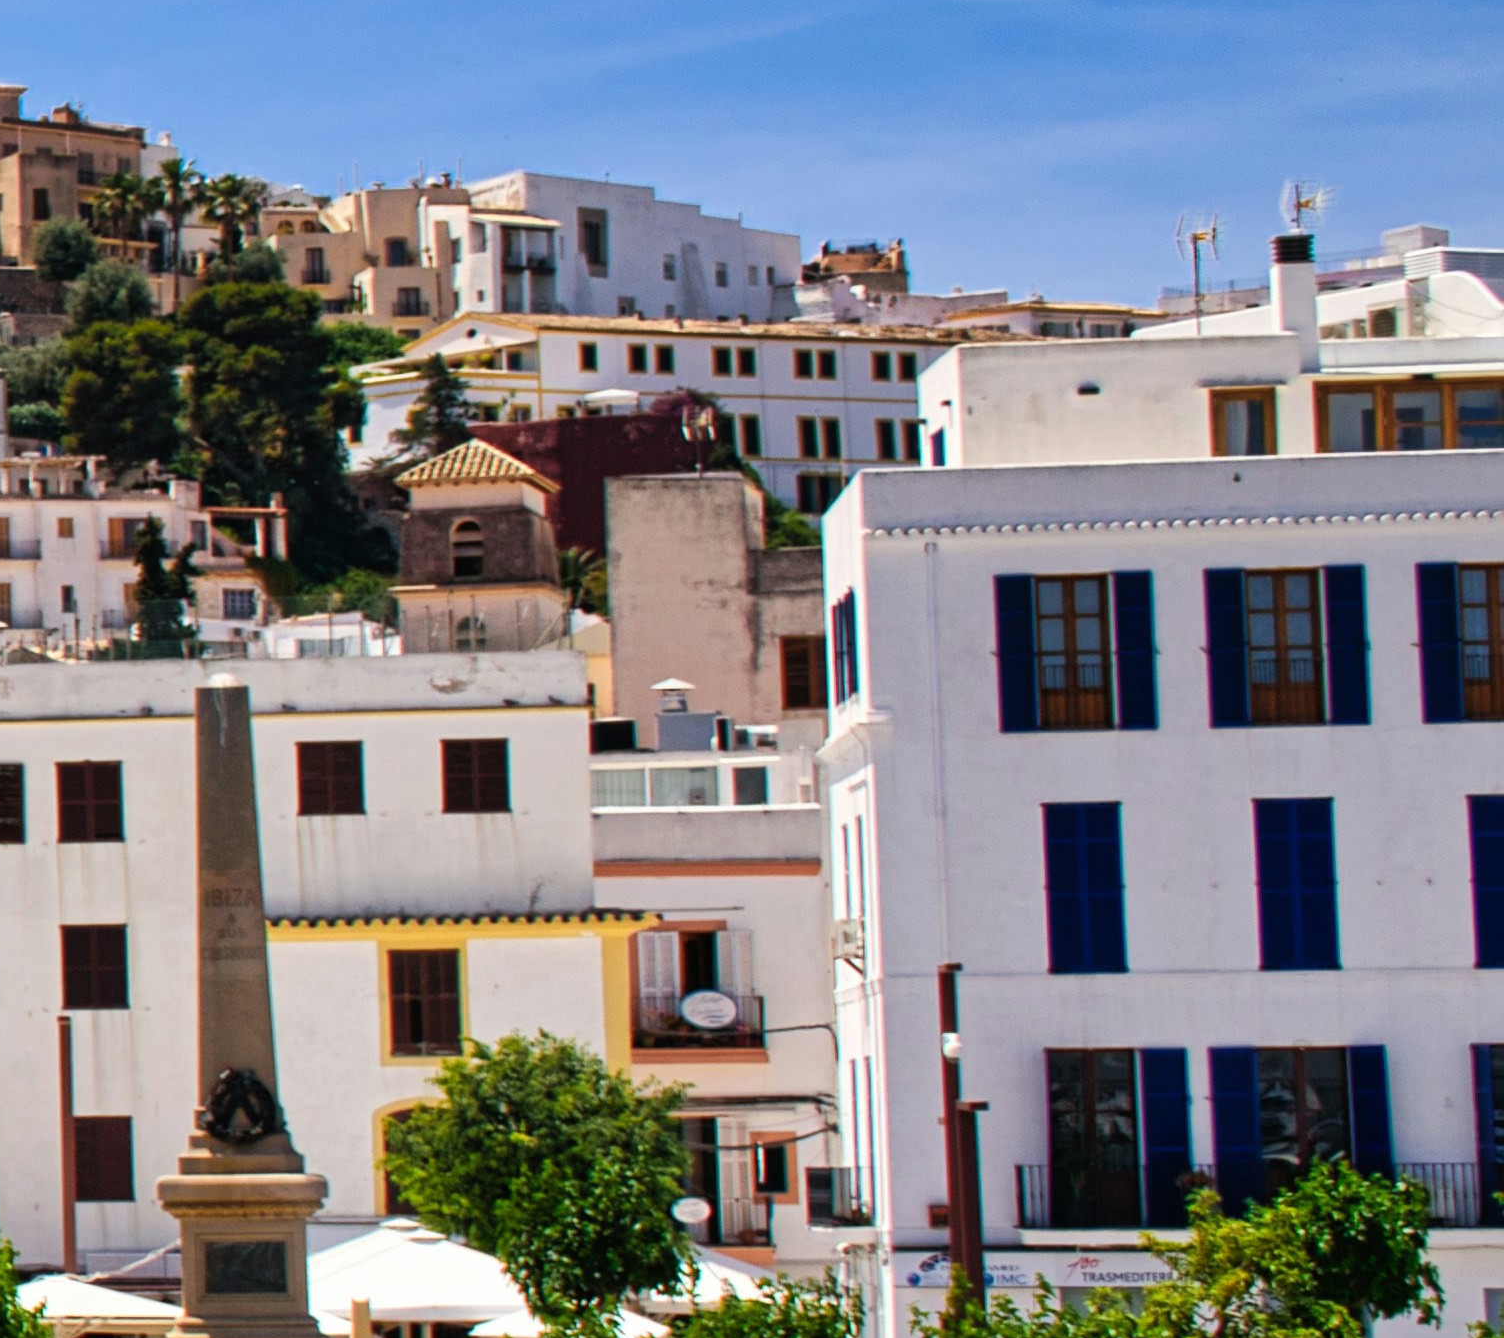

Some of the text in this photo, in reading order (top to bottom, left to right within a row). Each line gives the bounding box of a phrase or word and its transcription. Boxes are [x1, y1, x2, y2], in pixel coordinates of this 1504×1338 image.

[204, 888, 257, 907] IBIZA
[996, 1273, 1027, 1285] IMC
[1081, 1271, 1174, 1283] TRASMEDITERR
